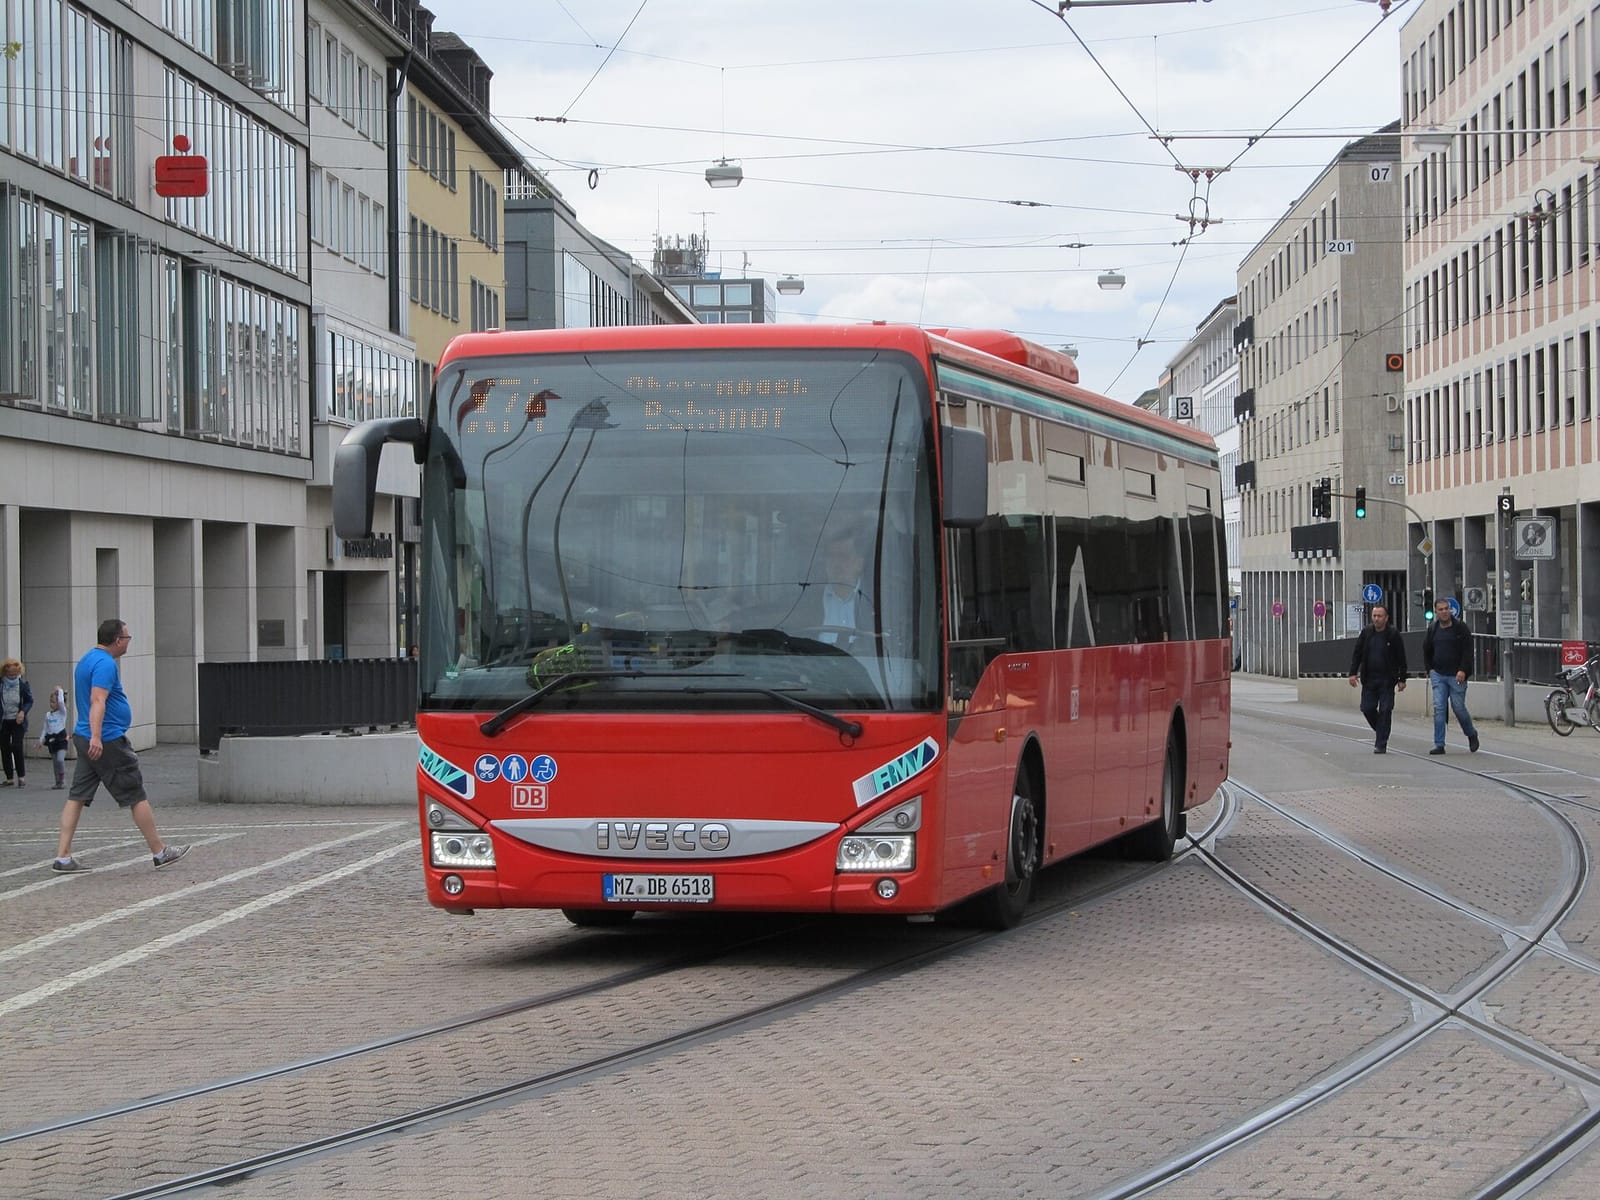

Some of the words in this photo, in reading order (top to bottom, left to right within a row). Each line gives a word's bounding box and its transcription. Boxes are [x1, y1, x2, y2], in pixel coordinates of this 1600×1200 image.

[1371, 168, 1390, 181] 07
[1328, 242, 1352, 252] 201
[1180, 401, 1189, 416] 3
[1502, 498, 1510, 510] S
[516, 788, 543, 806] DB
[597, 822, 731, 851] IVECO
[614, 878, 635, 895] MZ
[647, 878, 667, 895] DB
[671, 878, 711, 895] 6518
